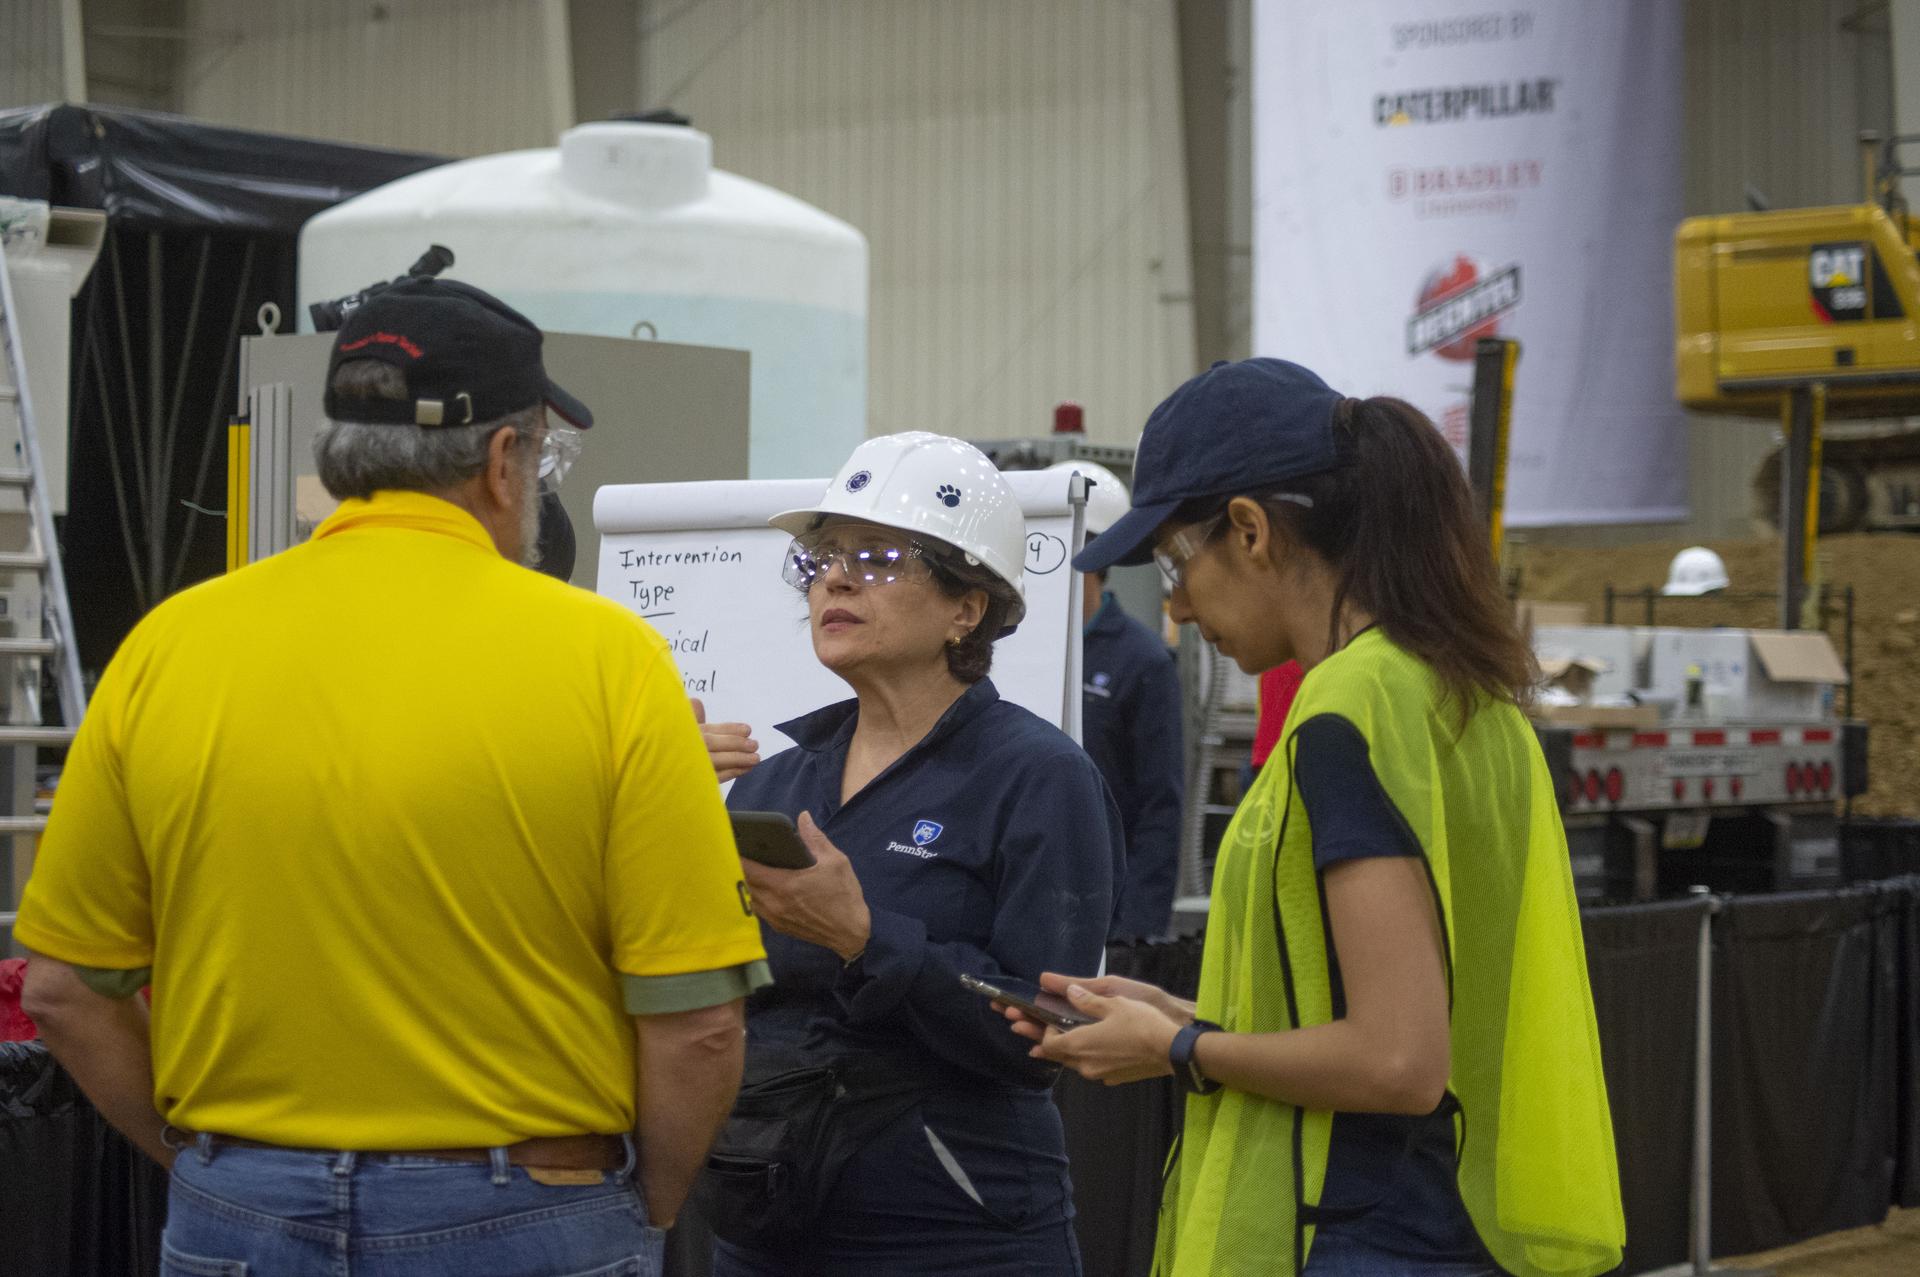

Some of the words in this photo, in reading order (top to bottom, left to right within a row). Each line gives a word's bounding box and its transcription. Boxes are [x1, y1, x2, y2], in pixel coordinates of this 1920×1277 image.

[1374, 77, 1556, 126] CATERPILLAR
[1811, 248, 1864, 290] CAT
[619, 546, 742, 569] Intervention
[1029, 540, 1042, 562] 4
[629, 580, 675, 610] Type
